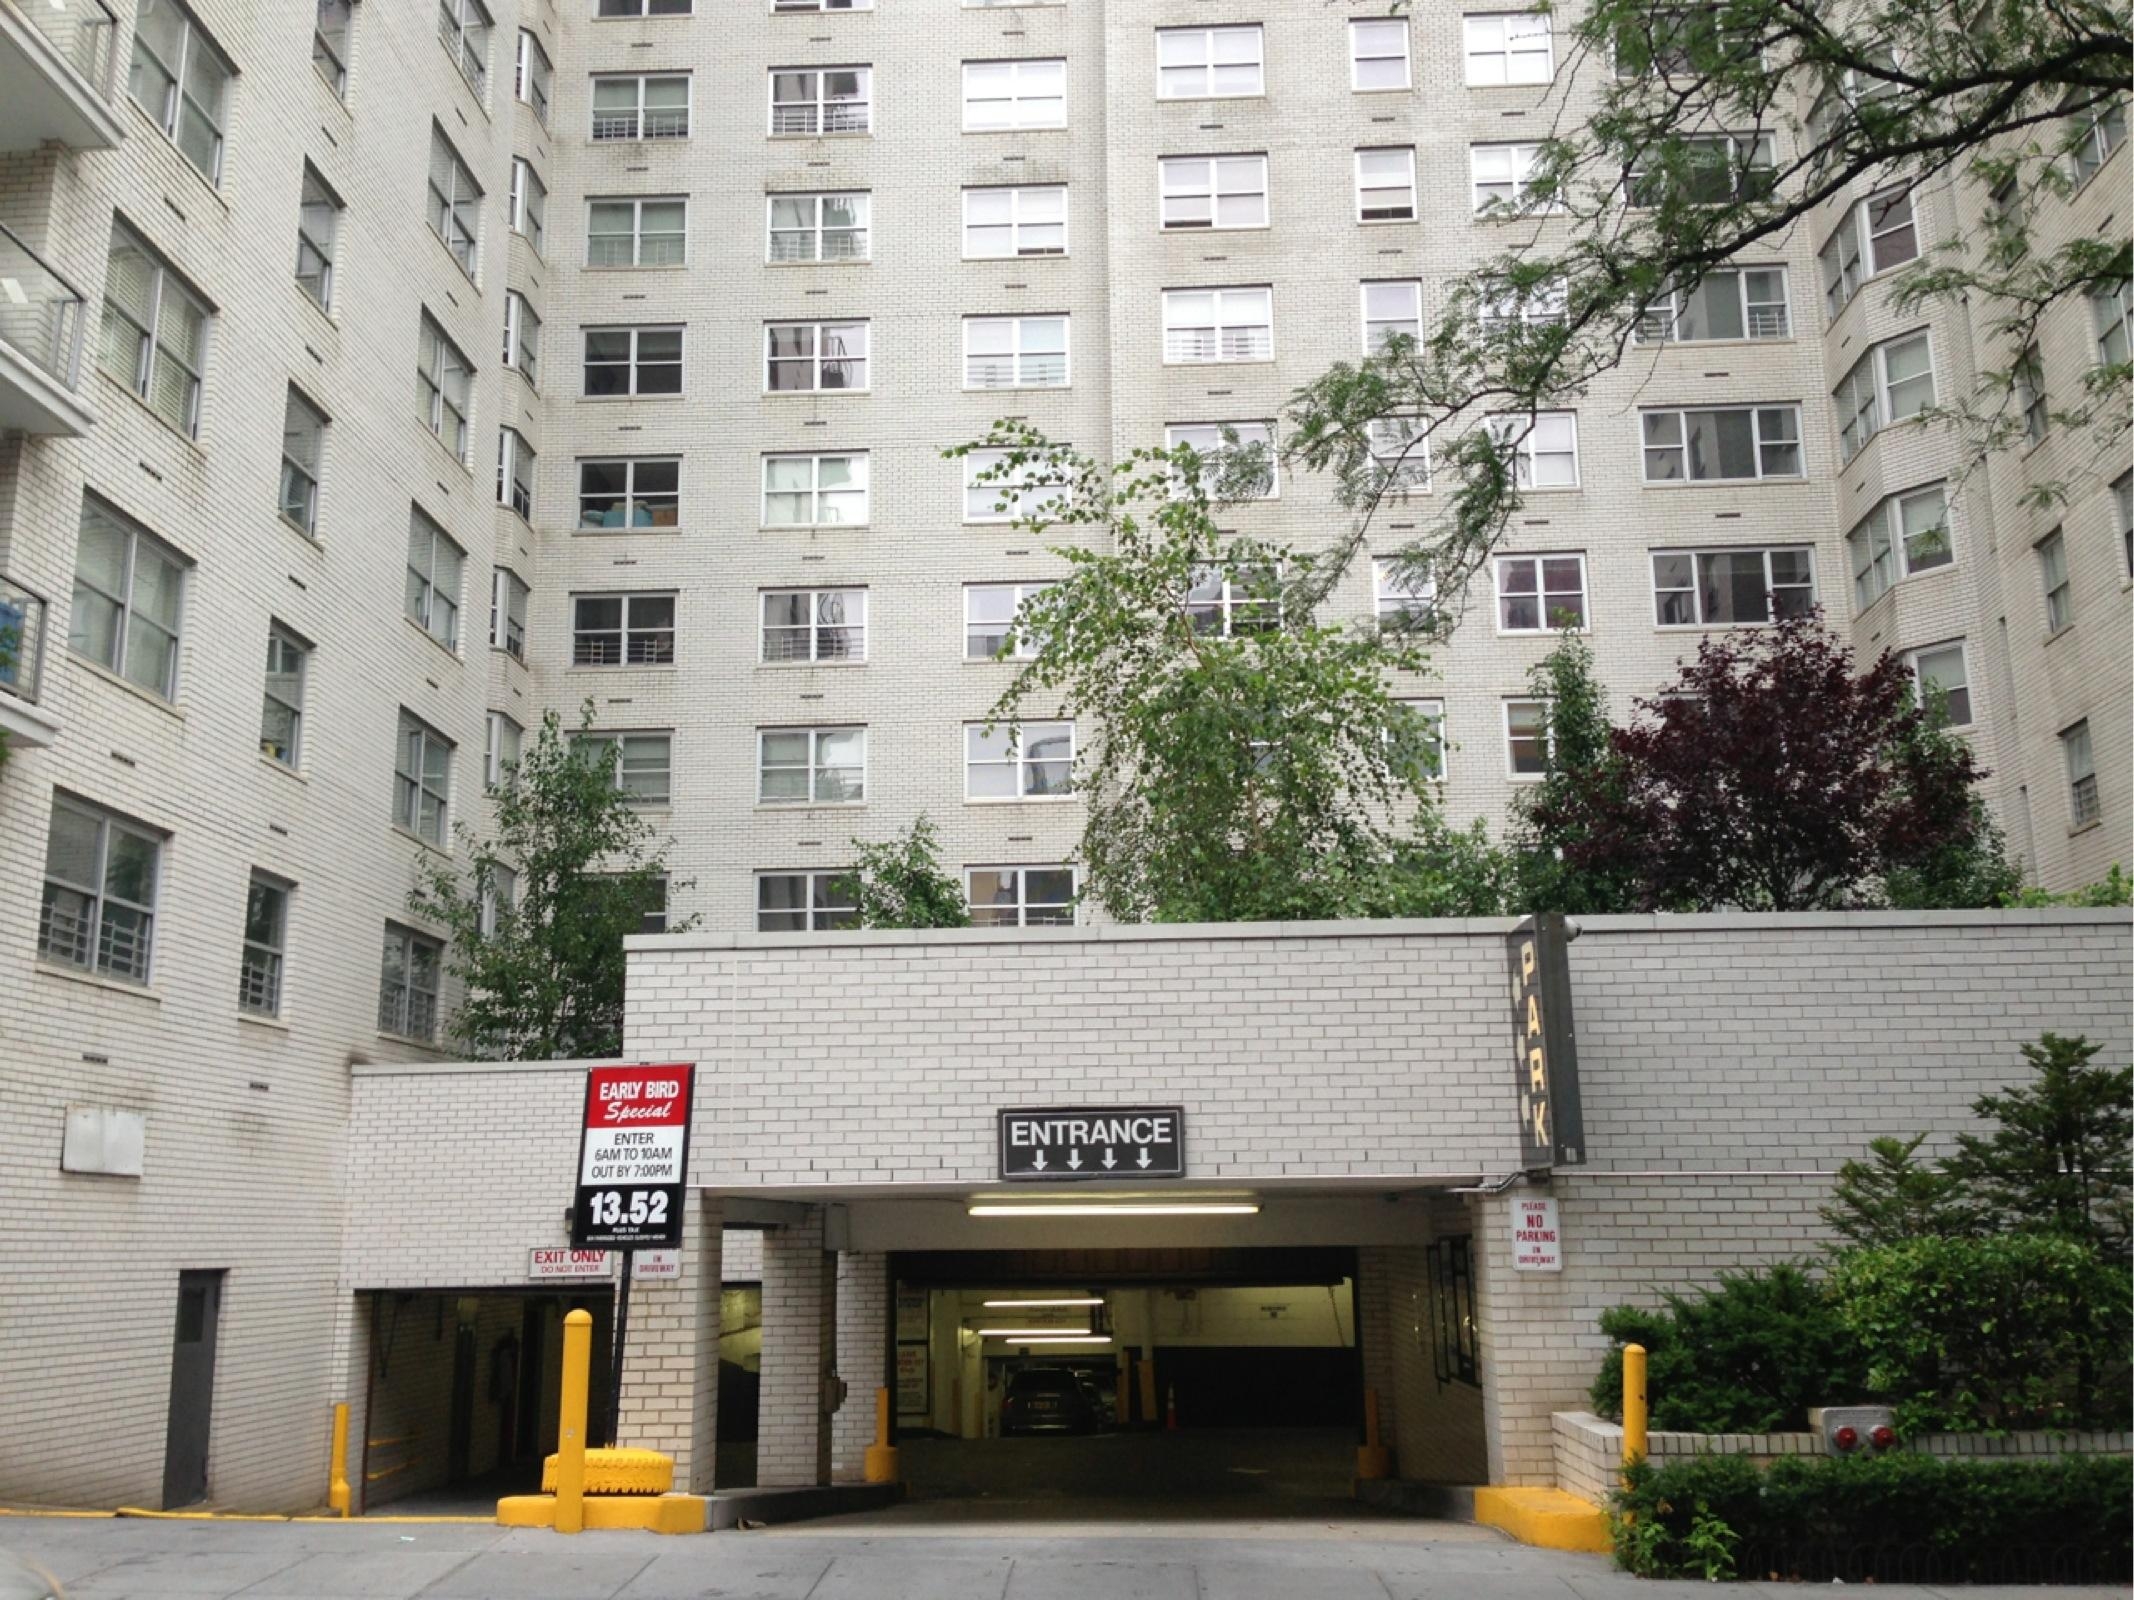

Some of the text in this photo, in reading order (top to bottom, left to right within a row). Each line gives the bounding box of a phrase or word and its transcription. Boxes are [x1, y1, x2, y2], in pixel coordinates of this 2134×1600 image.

[1520, 940, 1549, 1147] PARK
[600, 1080, 679, 1100] EARLY BIRD
[604, 1101, 672, 1123] Special
[614, 1132, 654, 1145] ENTER
[1010, 1117, 1172, 1146] ENTRANCE
[594, 1147, 672, 1161] 6AM TO 10AM
[591, 1164, 672, 1178] OUT BY 7:00PM
[590, 1190, 668, 1225] 13.52
[1521, 1202, 1546, 1210] PLEASE
[1527, 1214, 1543, 1228] NO
[1516, 1231, 1556, 1242] PARKING
[534, 1249, 606, 1264] EXIT ONLY
[653, 1255, 662, 1263] IN
[555, 1265, 572, 1273] NOT
[639, 1264, 675, 1273] DRIVEWAY
